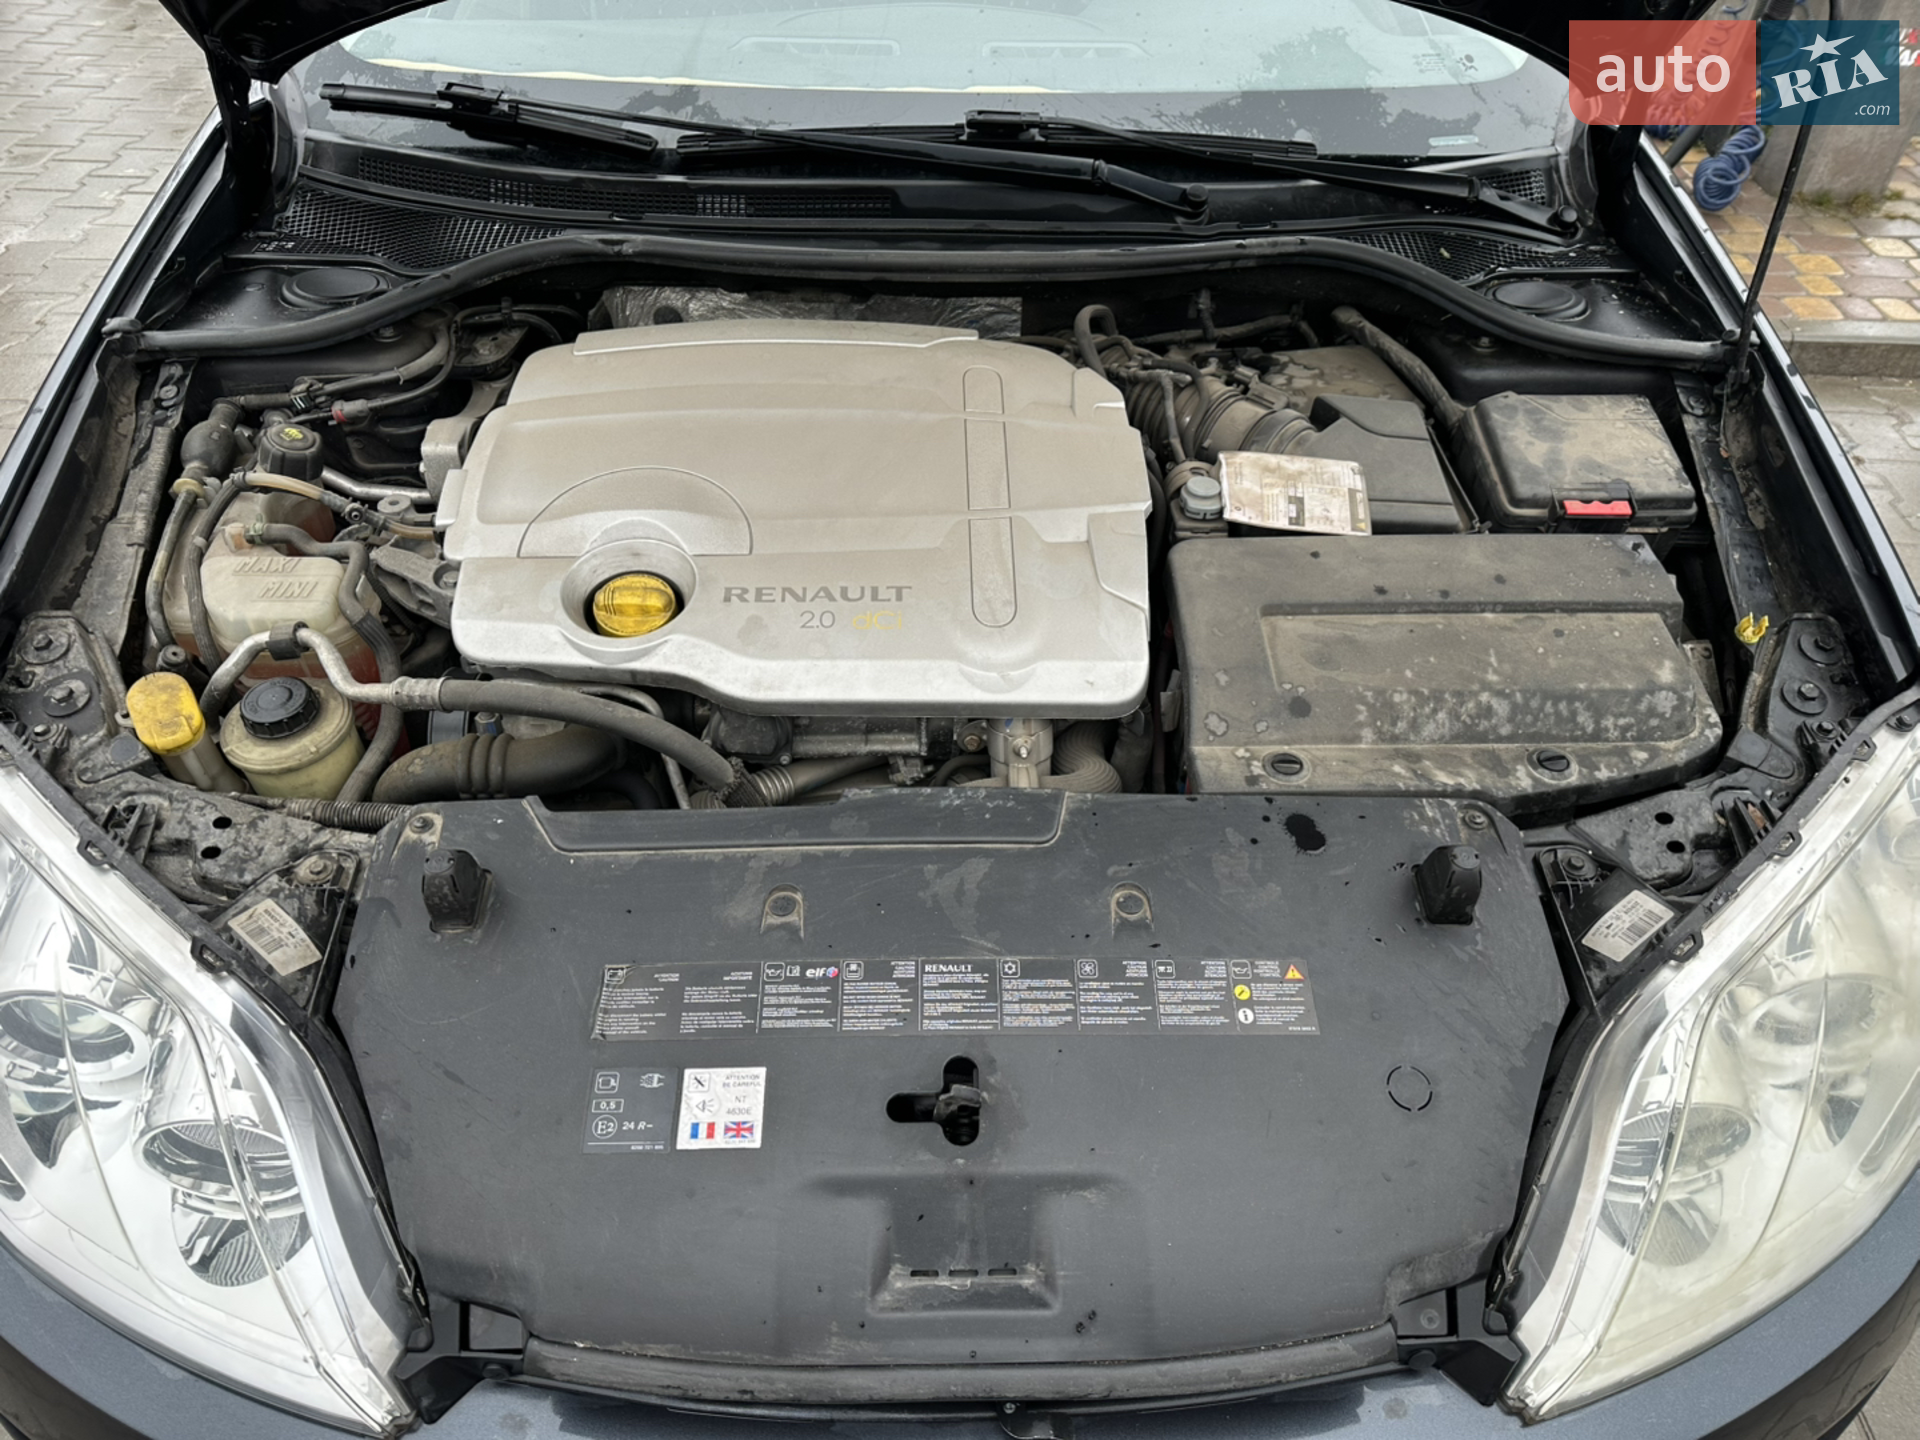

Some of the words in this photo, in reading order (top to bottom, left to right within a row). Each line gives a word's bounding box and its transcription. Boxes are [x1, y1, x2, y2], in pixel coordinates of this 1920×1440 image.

[233, 556, 301, 573] MAXI
[258, 581, 319, 598] MINI
[722, 586, 913, 603] RENAULT
[799, 610, 836, 629] 2.0
[805, 967, 827, 978] elf
[924, 964, 972, 972] RENAULT
[600, 1101, 616, 1111] 0,5
[597, 1120, 614, 1134] E2
[622, 1120, 635, 1130] 24
